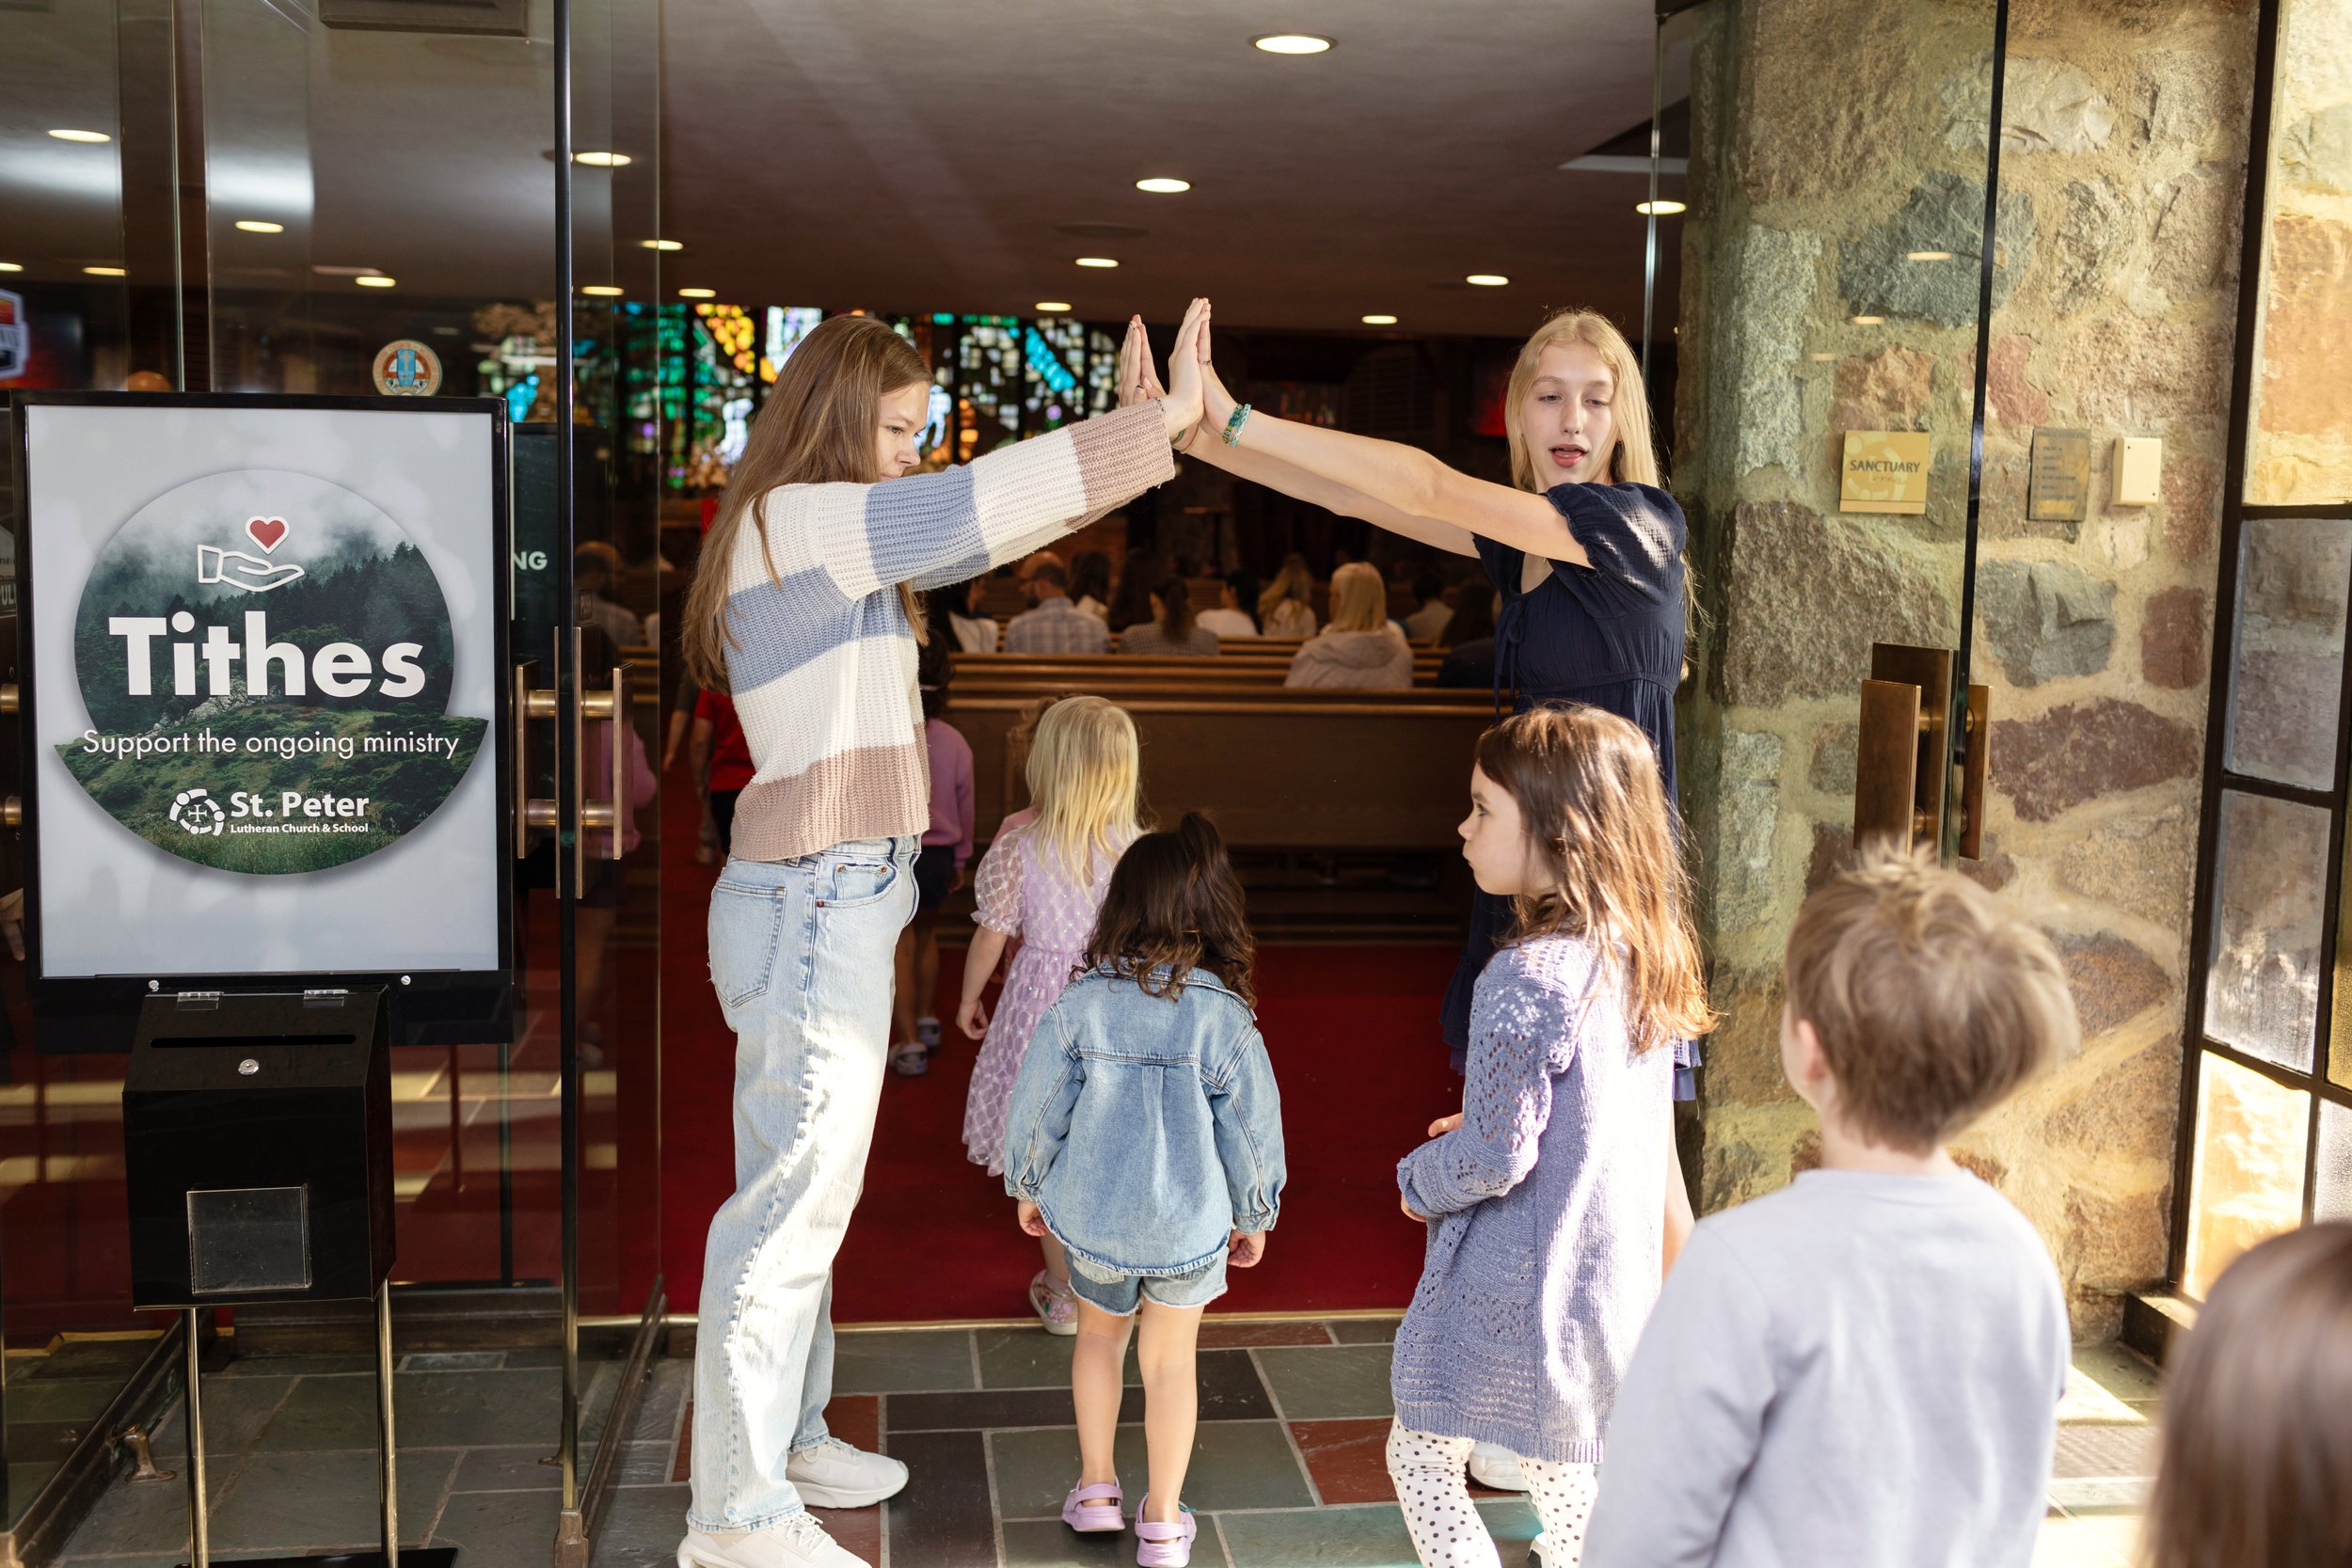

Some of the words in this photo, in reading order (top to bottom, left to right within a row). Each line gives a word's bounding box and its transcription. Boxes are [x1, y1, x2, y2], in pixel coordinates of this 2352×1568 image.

[1850, 459, 1921, 473] SANCTUARY
[108, 610, 426, 698] Tithes
[83, 729, 191, 760] Support
[197, 727, 237, 753] the
[246, 730, 354, 760] ongoing
[363, 730, 460, 760] ministry
[230, 791, 274, 818] St.
[281, 791, 370, 817] Peter
[230, 823, 280, 834] Lutheran
[280, 823, 321, 833] Church
[322, 823, 331, 833] &
[332, 823, 369, 833] School
